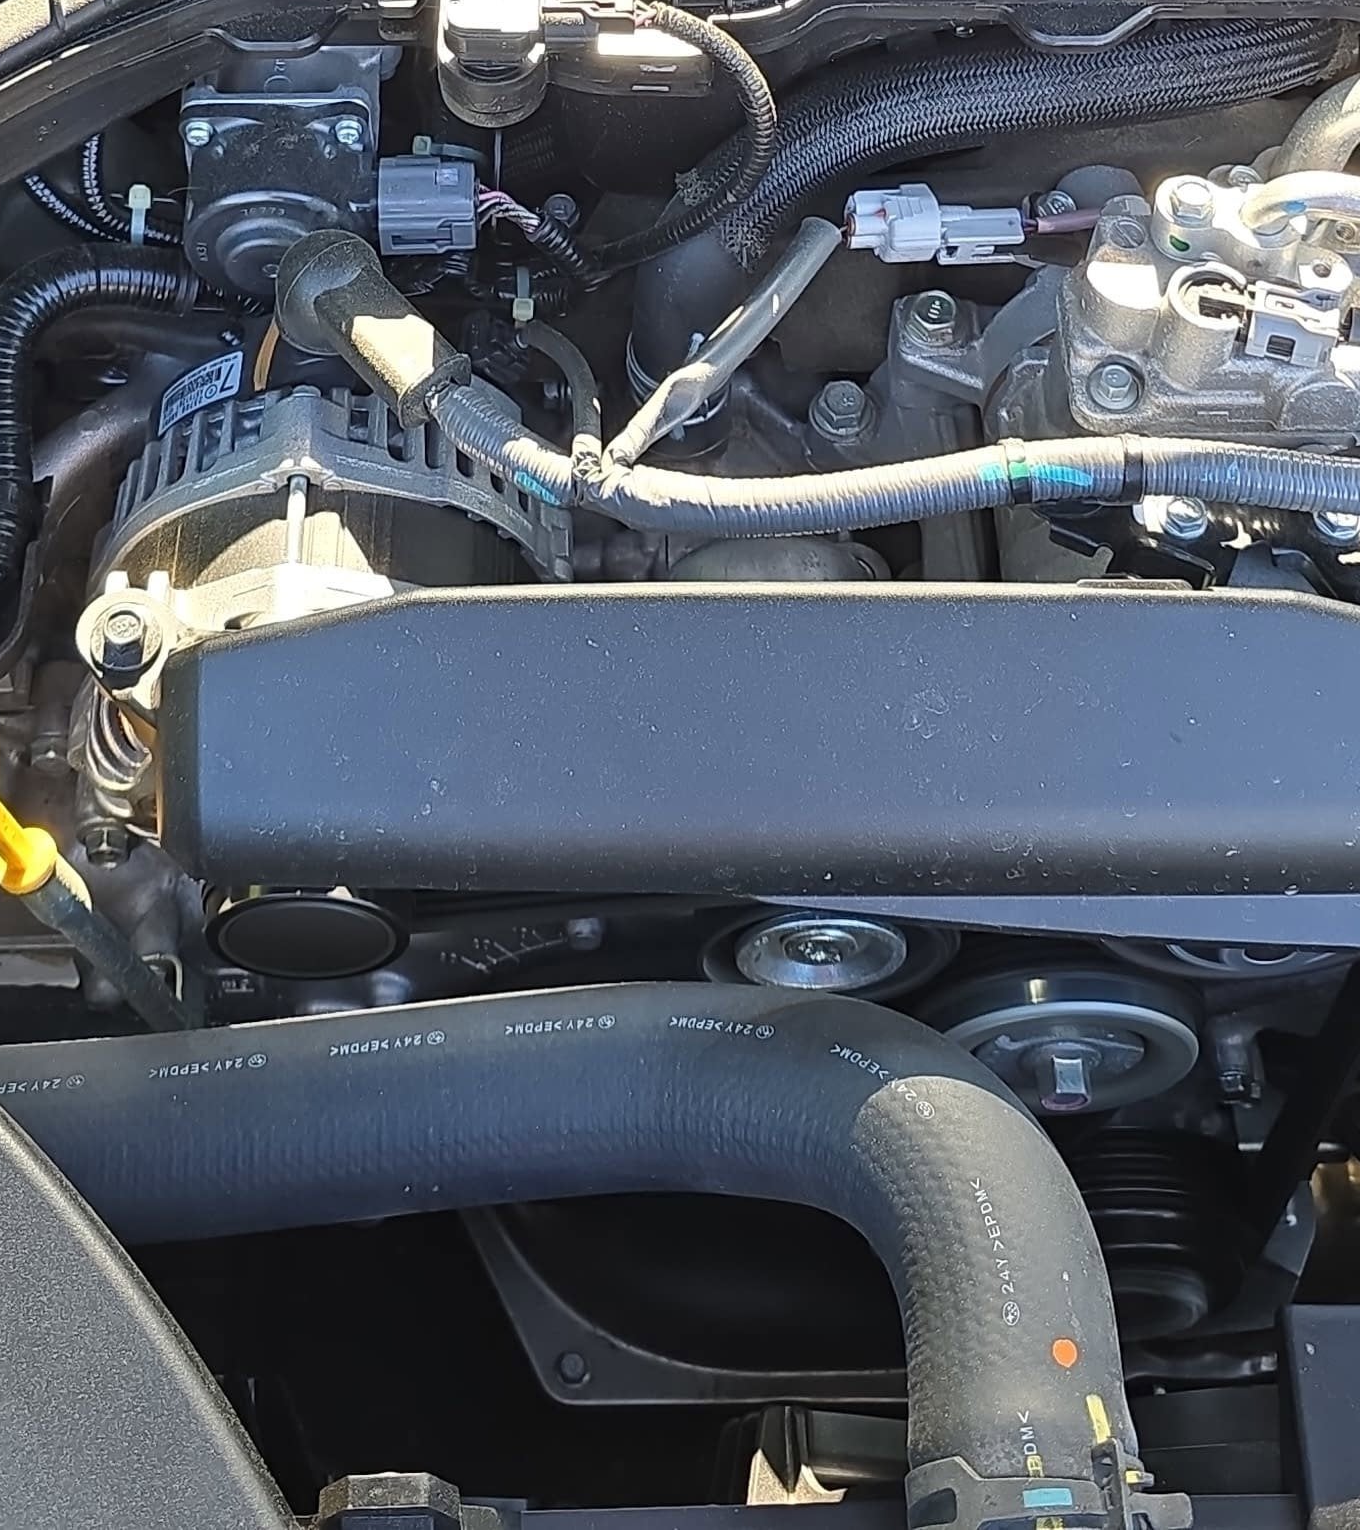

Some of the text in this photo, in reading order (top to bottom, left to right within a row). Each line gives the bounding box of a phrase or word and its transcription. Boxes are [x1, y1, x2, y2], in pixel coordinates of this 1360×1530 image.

[566, 1017, 595, 1032] 24Y
[724, 1021, 752, 1036] 24Y
[394, 1034, 423, 1049] 24Y
[215, 1056, 243, 1071] 24Y
[30, 1077, 62, 1092] 24Y
[995, 1257, 1014, 1295] 24Y
